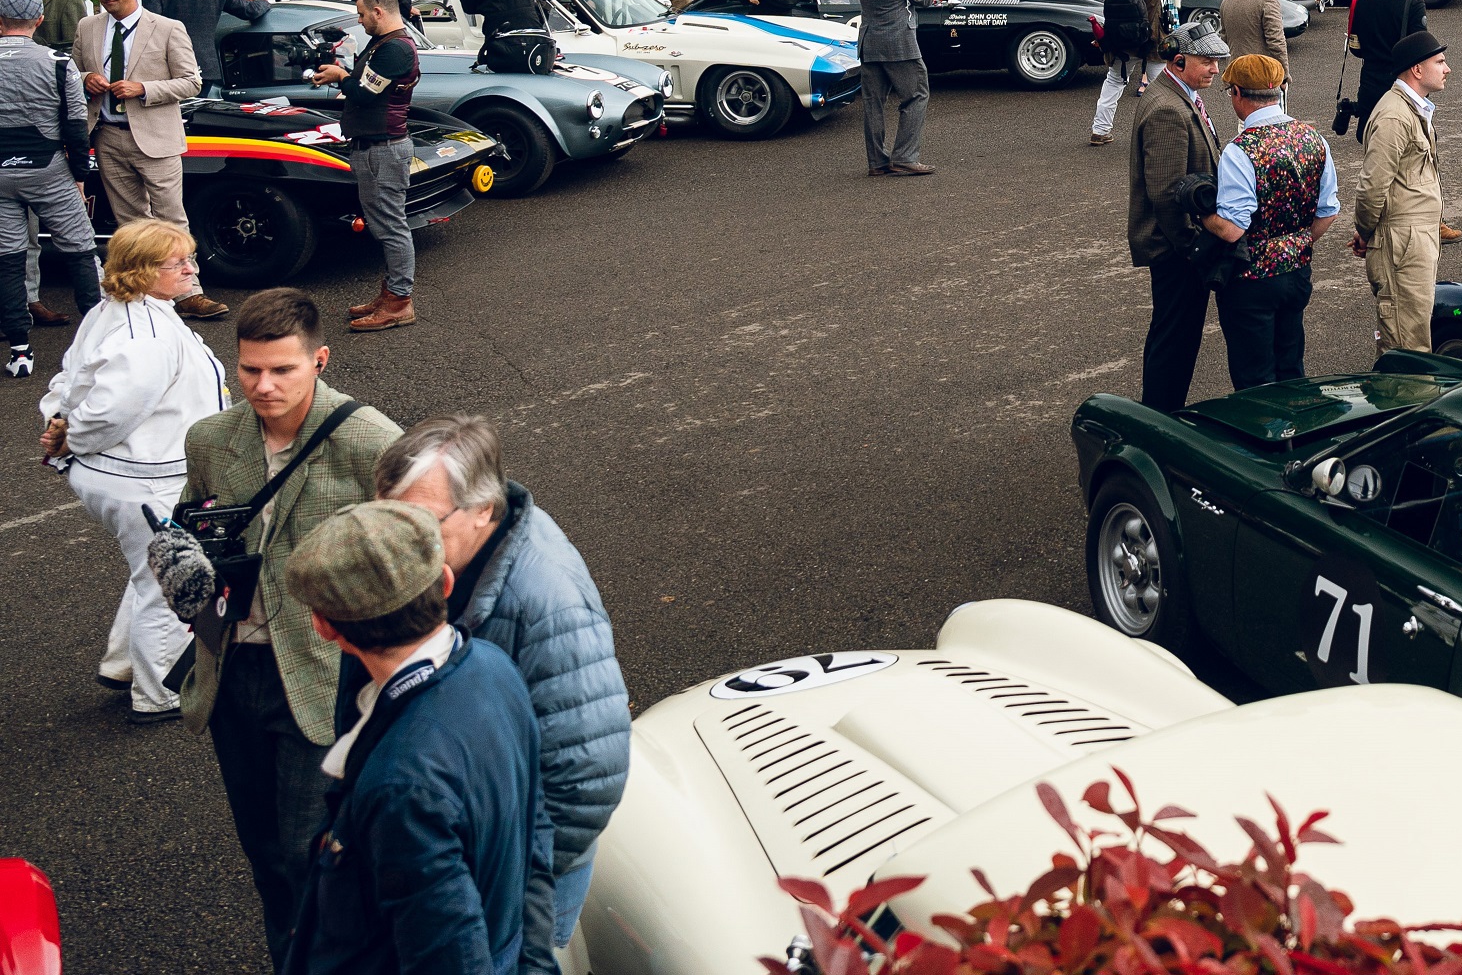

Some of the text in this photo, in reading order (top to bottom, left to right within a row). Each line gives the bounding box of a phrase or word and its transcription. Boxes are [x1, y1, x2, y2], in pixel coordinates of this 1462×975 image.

[986, 13, 1008, 21] QUICK
[365, 72, 383, 87] MEDIA
[1190, 487, 1225, 515] Tiger
[1314, 574, 1374, 685] 71
